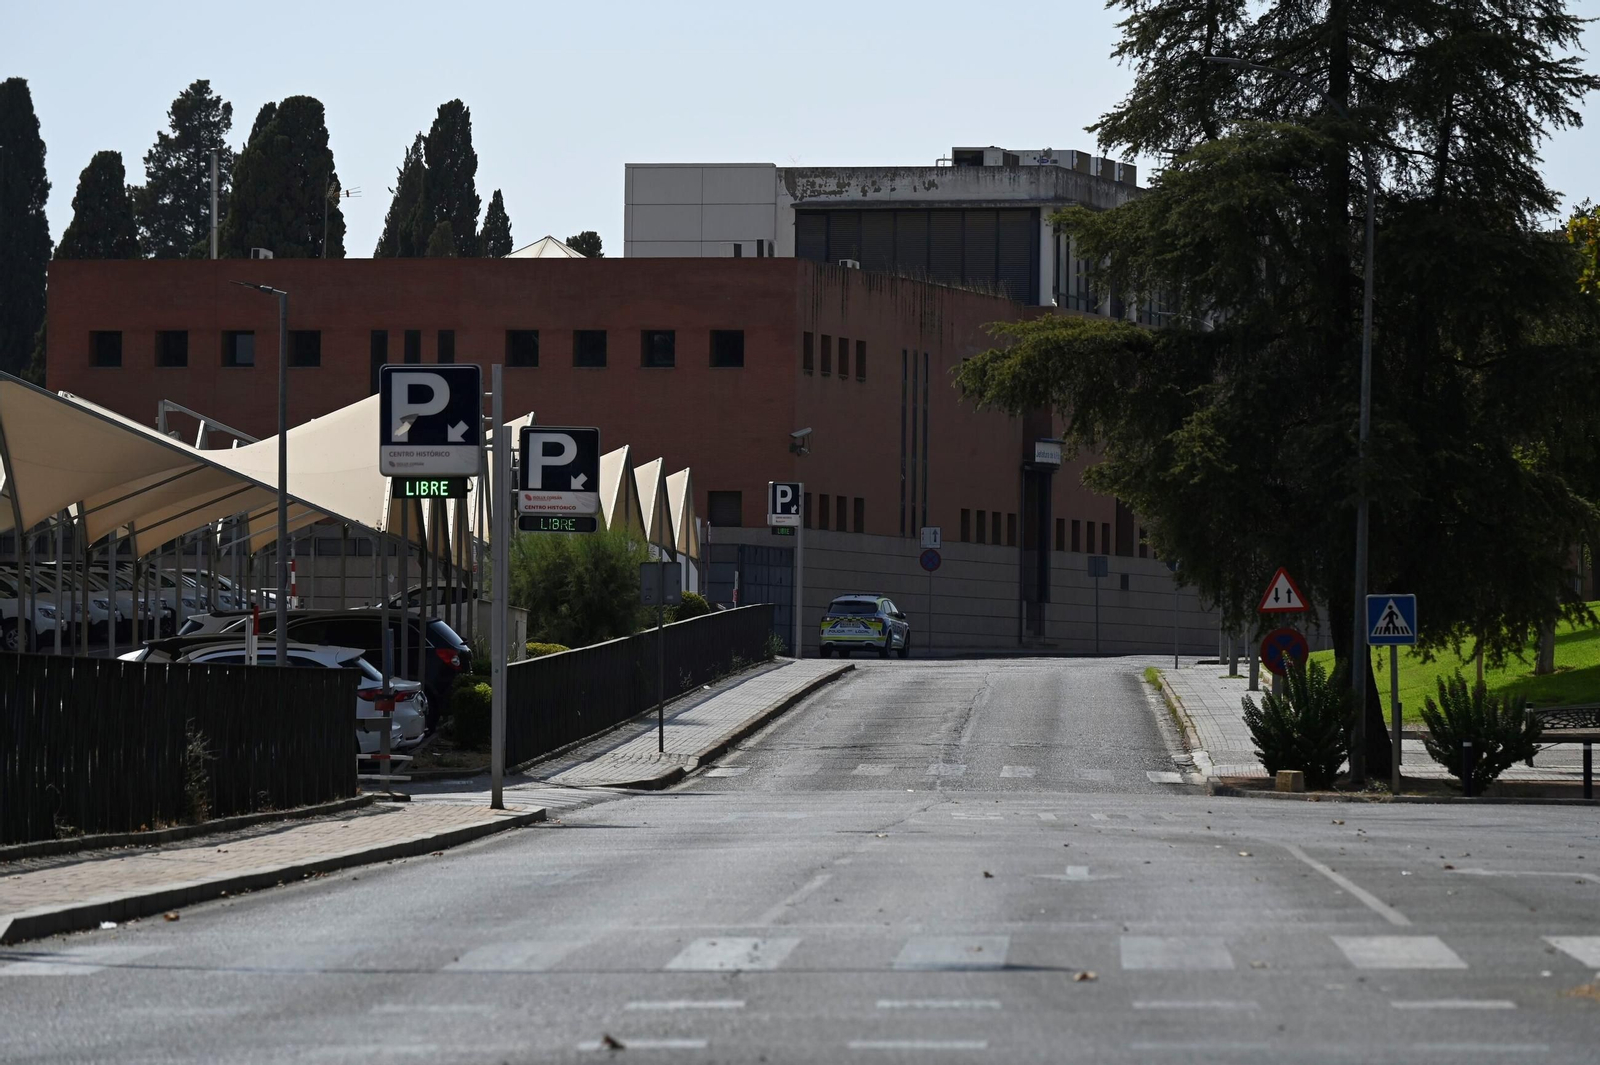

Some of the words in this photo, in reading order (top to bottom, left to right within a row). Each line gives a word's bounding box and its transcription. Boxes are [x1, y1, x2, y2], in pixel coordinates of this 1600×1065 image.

[391, 372, 450, 443] P
[416, 450, 450, 458] HISTÓRICO
[528, 432, 577, 489] P
[406, 481, 448, 496] LIBRE
[776, 485, 792, 513] P
[540, 518, 576, 530] LIBRE
